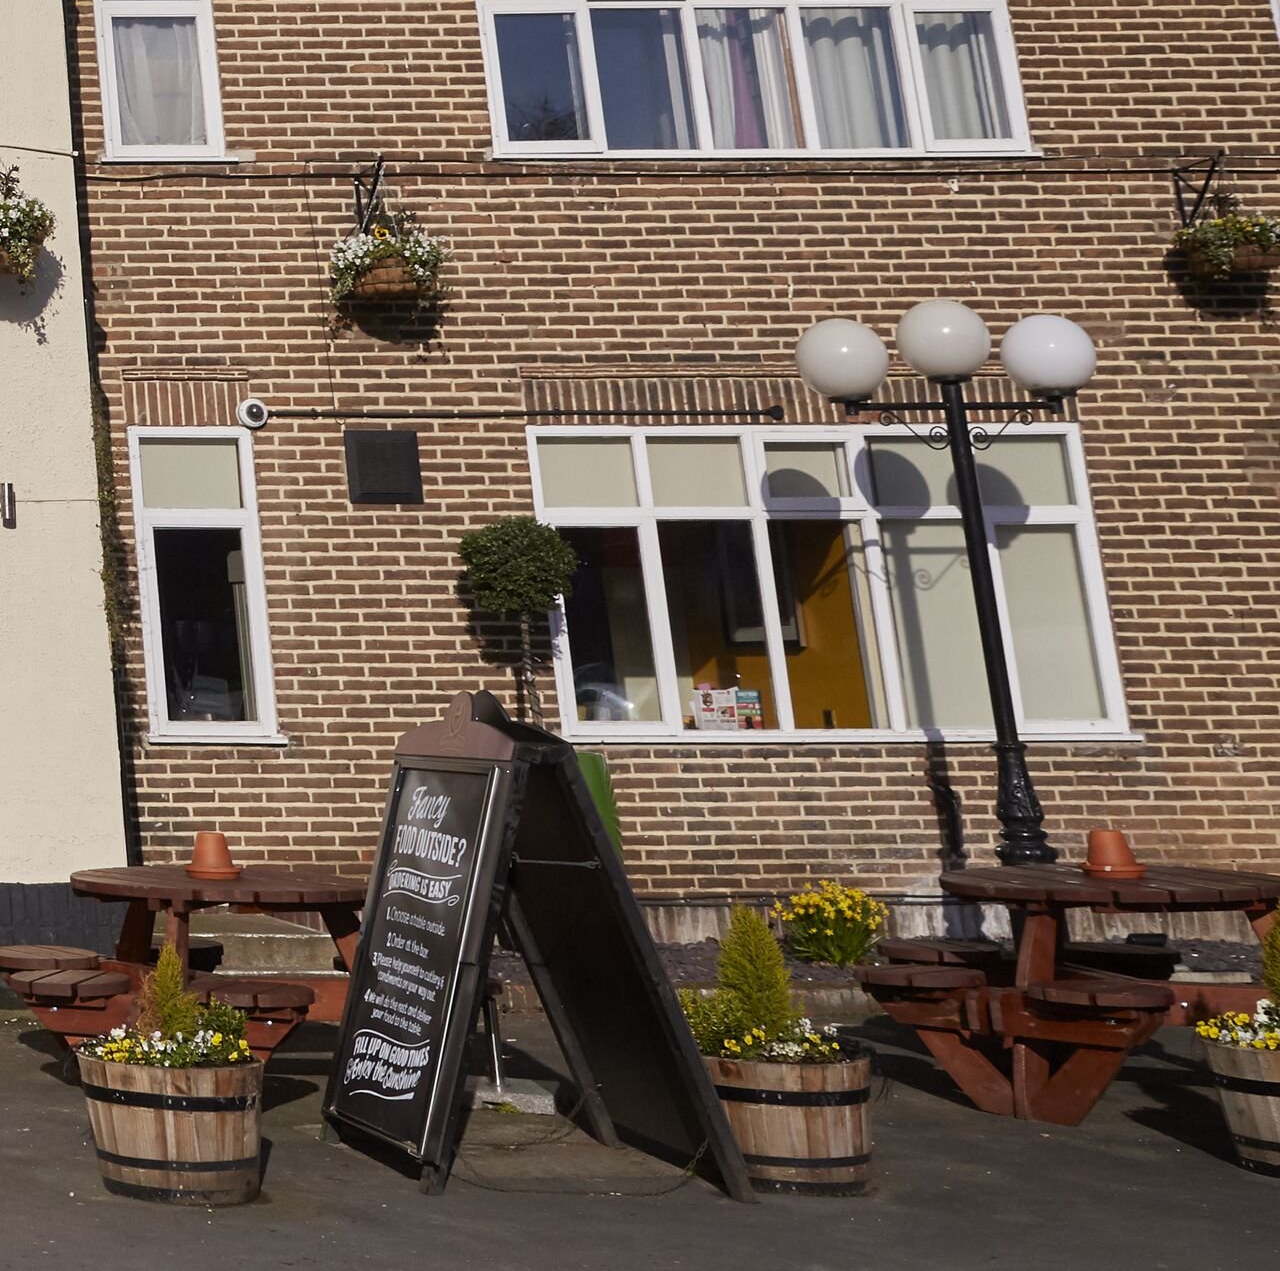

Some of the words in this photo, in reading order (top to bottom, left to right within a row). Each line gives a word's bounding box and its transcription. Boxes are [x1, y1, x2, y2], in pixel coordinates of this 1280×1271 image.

[408, 786, 451, 828] Fancy
[394, 825, 417, 854] FOOD
[415, 829, 467, 867] OUTSIDE?
[389, 872, 421, 891] ORDERING
[420, 879, 428, 896] IS
[428, 880, 452, 898] EASY
[353, 1036, 369, 1056] FILL
[368, 1037, 382, 1056] UP
[379, 1042, 391, 1060] ON
[389, 1046, 409, 1067] GOOD
[407, 1046, 430, 1067] TIMES
[352, 1055, 375, 1080] Enjoy
[372, 1059, 387, 1082] the
[382, 1067, 421, 1090] Sunshine
